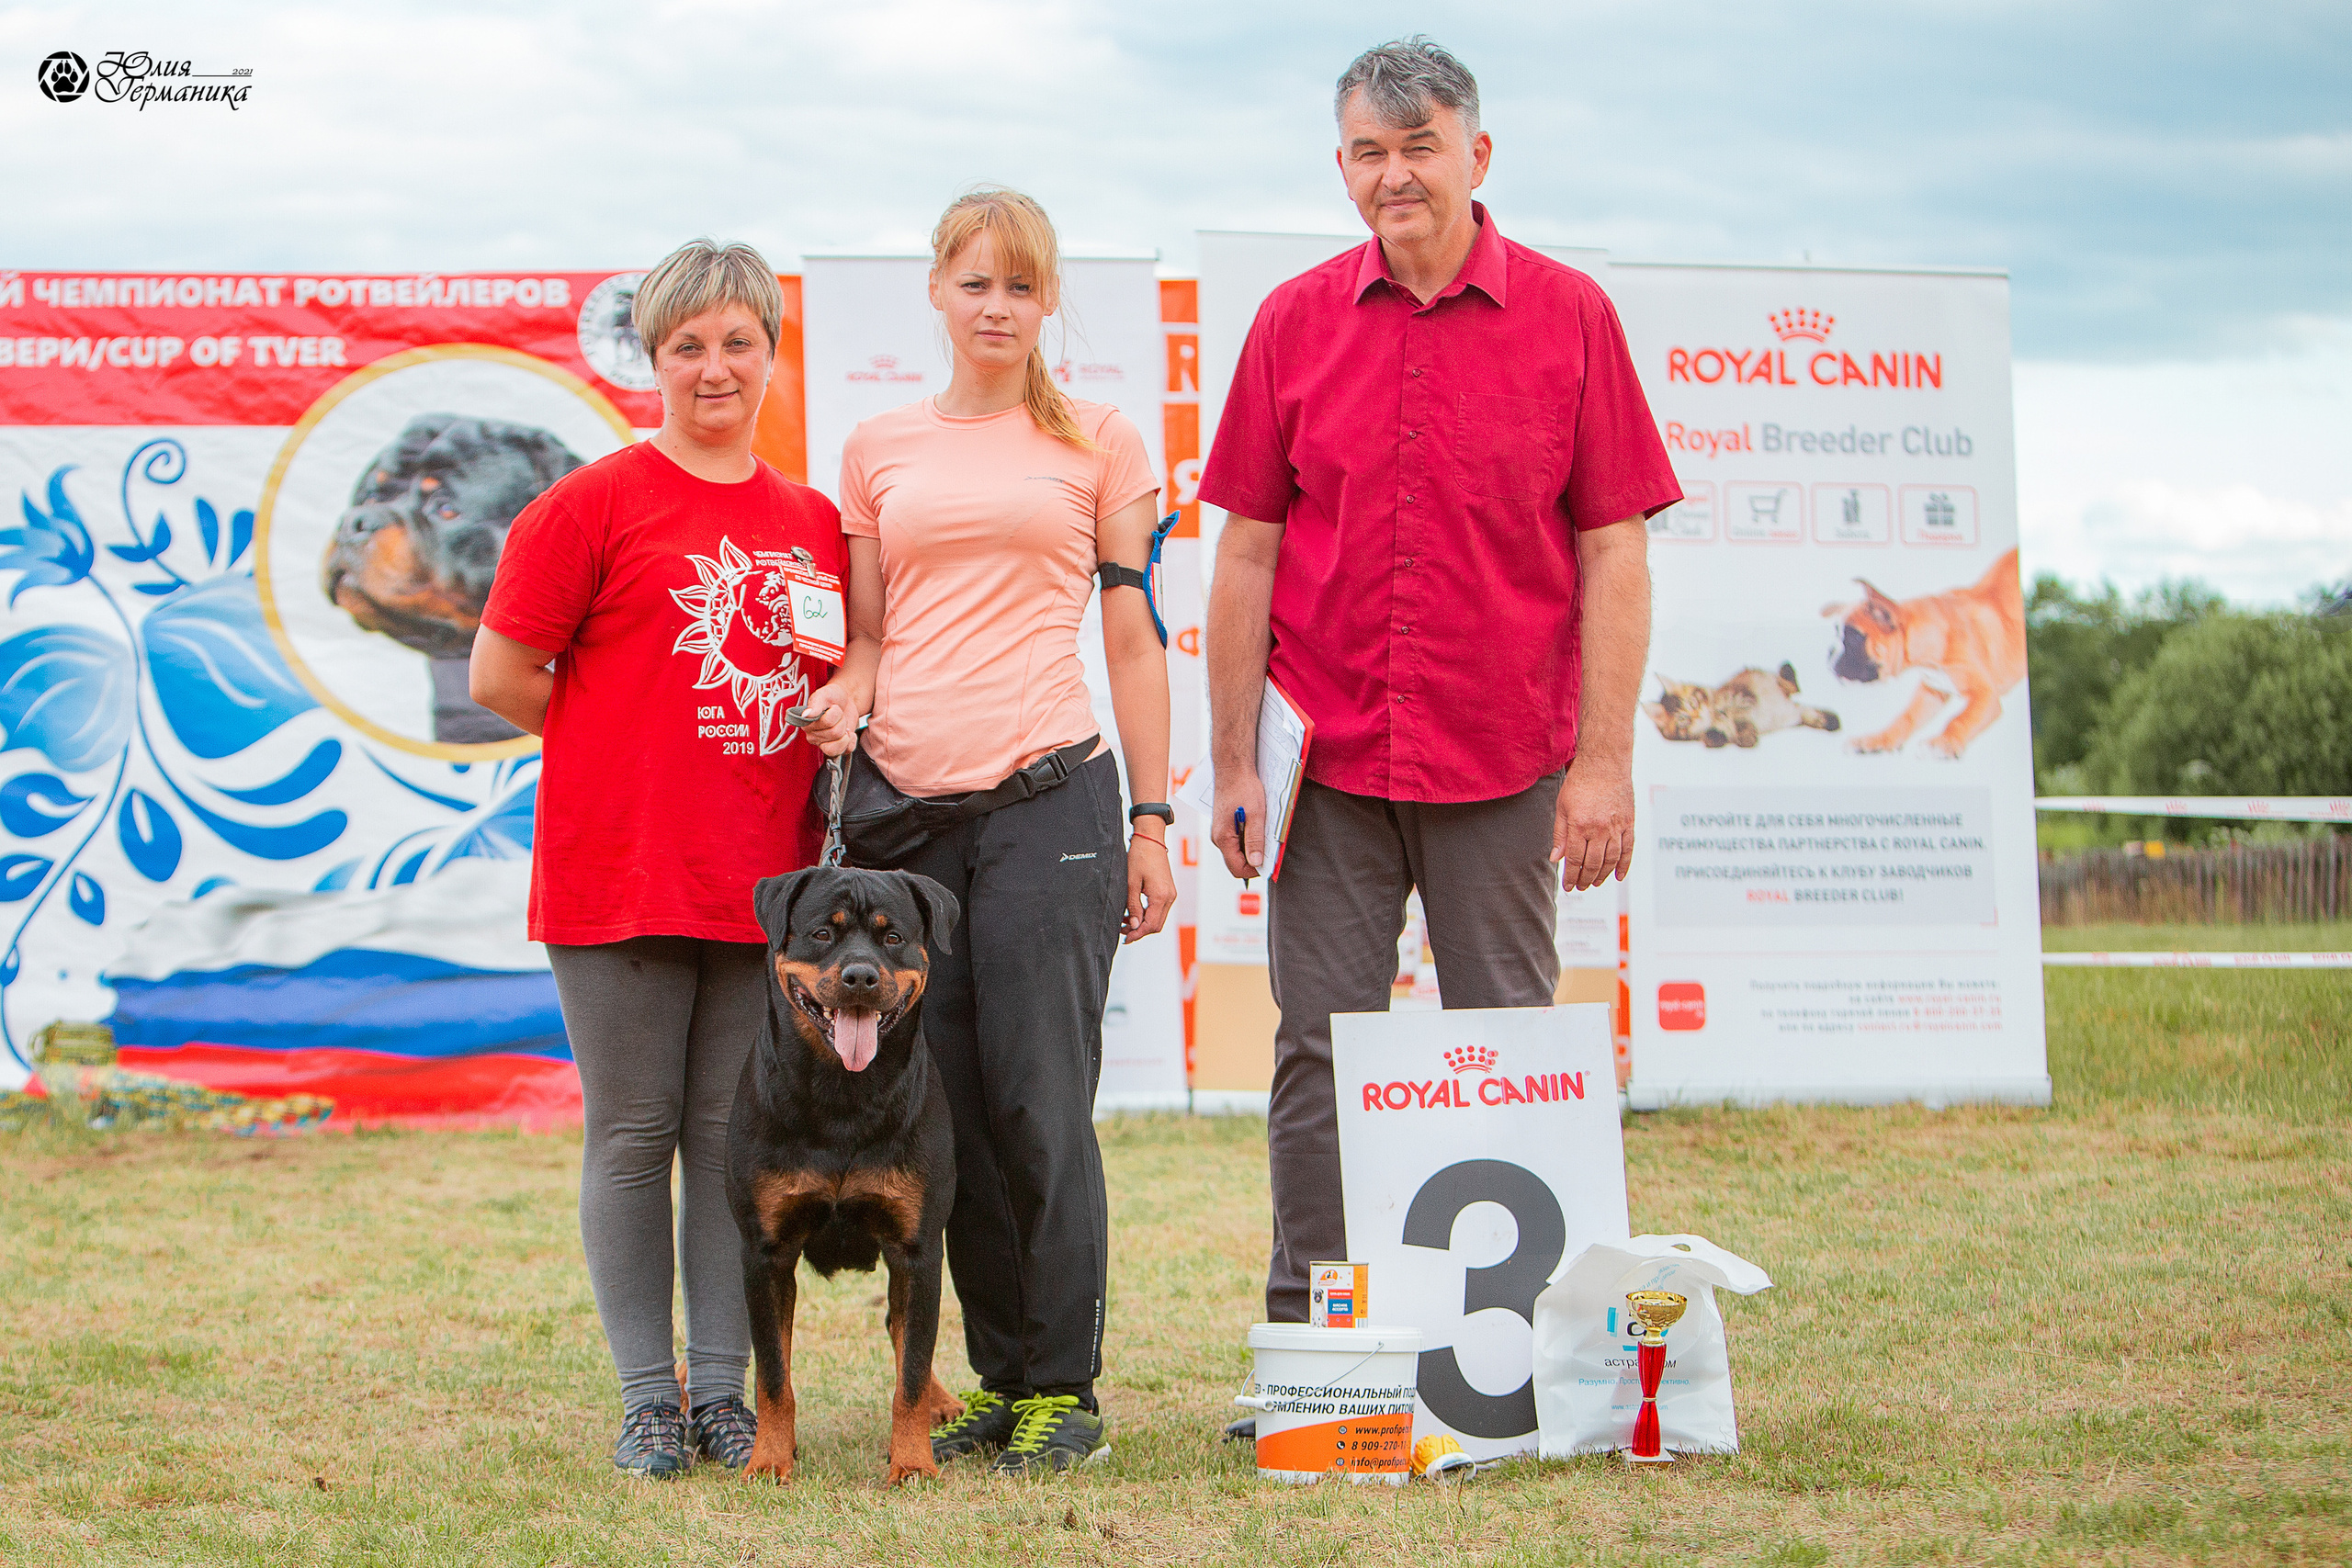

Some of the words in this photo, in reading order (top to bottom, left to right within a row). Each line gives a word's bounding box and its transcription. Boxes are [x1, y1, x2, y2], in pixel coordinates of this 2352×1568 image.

[32, 276, 286, 309] ЧЕМПИОНАТ
[293, 274, 571, 308] РОТВЕЙЛЕРОВ
[189, 336, 243, 367] OF
[247, 336, 347, 367] TVER
[1668, 347, 1798, 386] ROYAL
[1809, 351, 1944, 389] CANIN
[1666, 421, 1754, 458] Royal
[1761, 422, 1893, 456] Breeder
[1902, 424, 1974, 457] Club
[802, 595, 828, 619] 62
[697, 705, 725, 719] ЮГА
[697, 724, 749, 739] РОССИИ
[722, 741, 754, 755] 2019
[1680, 812, 1751, 828] ОТКРОЙТЕ
[1754, 814, 1784, 829] ДЛЯ
[1893, 837, 1936, 851] ROYAL
[1069, 852, 1098, 861] DEMIX
[1747, 889, 1790, 903] ROYAL
[1794, 888, 1860, 903] BREEDER
[1363, 1078, 1470, 1111] ROYAL
[1478, 1071, 1585, 1106] CANIN
[1402, 1158, 1566, 1439] 3
[1578, 1378, 1618, 1387] Разумно.
[1267, 1383, 1402, 1399] ПРОФЕССИОНАЛЬНЫЙ
[1339, 1403, 1386, 1415] ВАШИХ
[1351, 1441, 1358, 1450] 8
